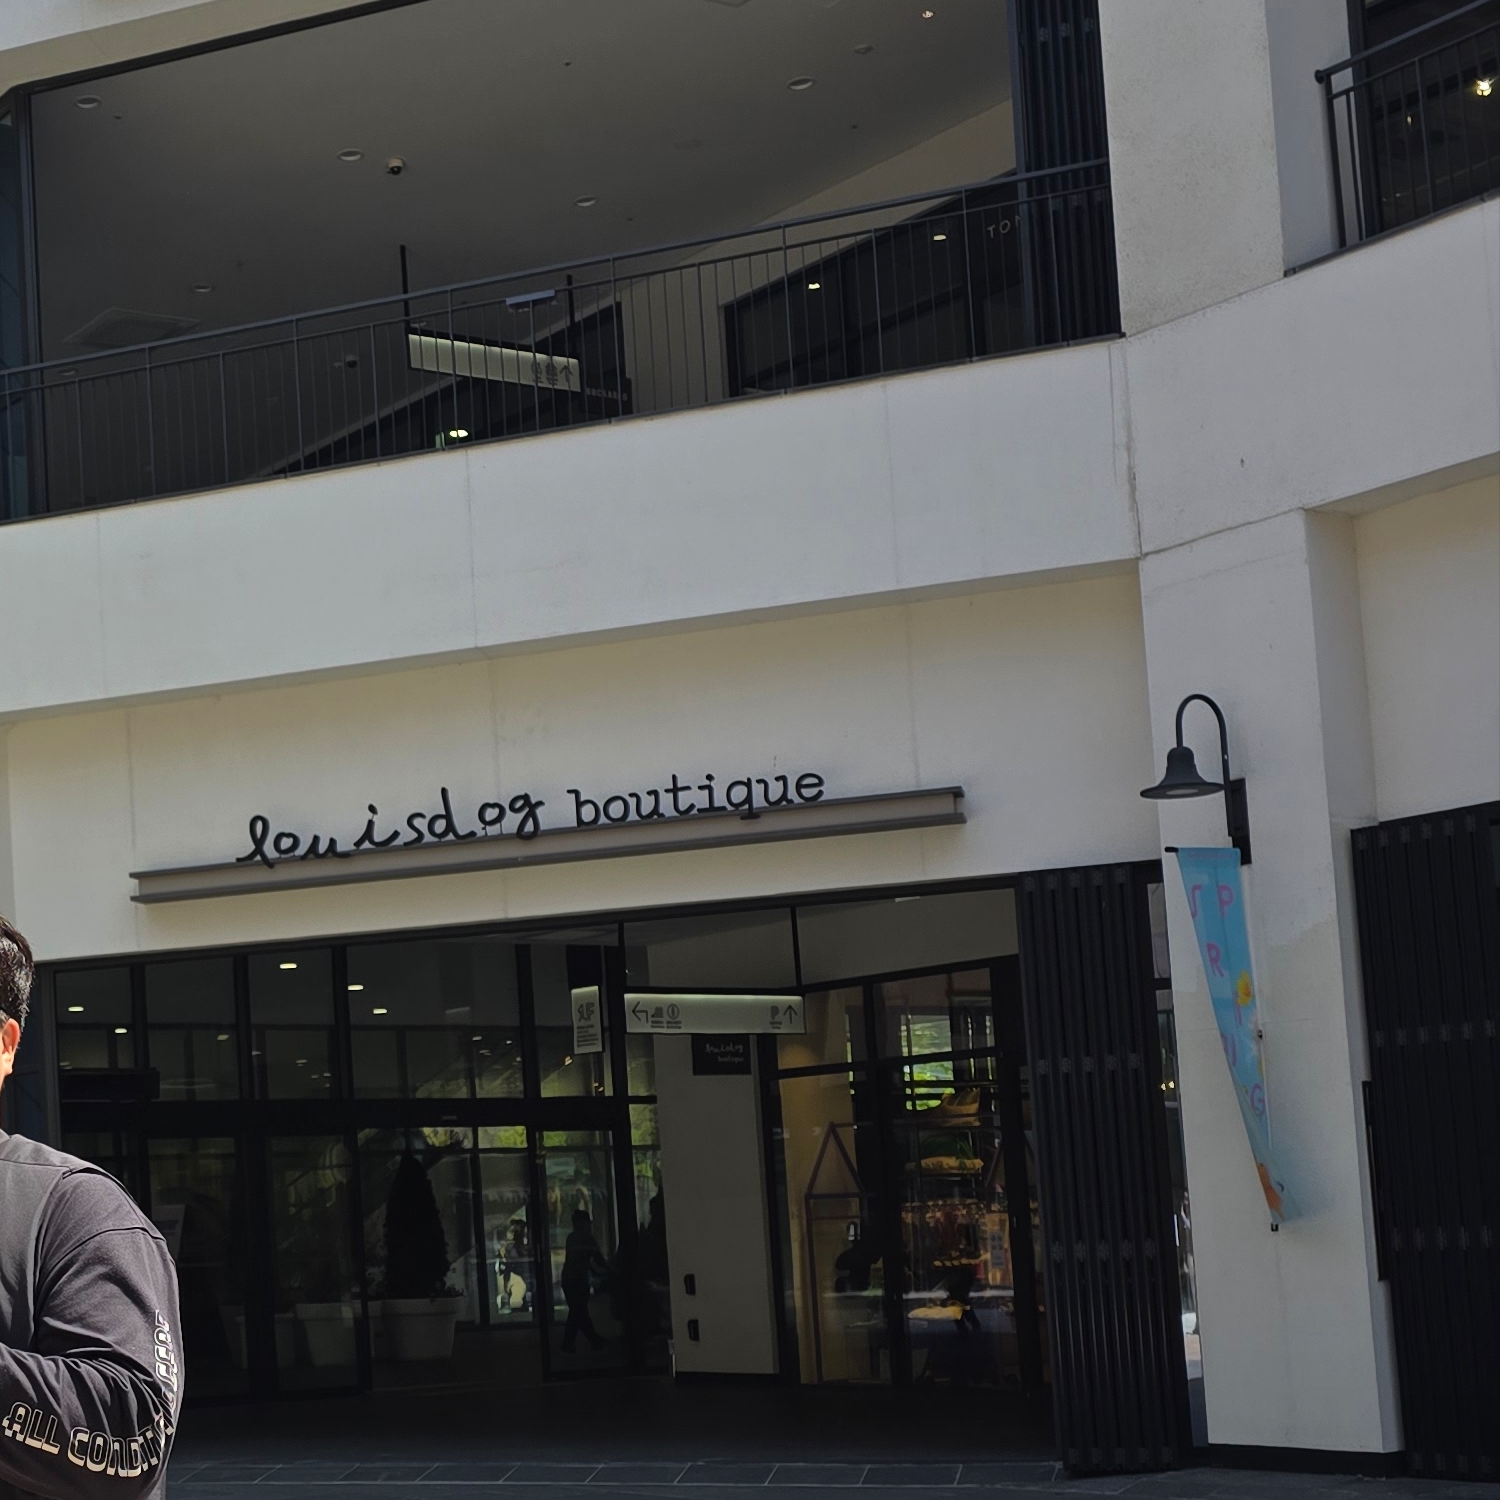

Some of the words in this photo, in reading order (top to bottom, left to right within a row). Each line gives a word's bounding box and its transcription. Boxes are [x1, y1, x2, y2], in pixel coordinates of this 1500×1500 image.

[236, 786, 545, 869] louisdog
[566, 772, 825, 821] boutique
[2, 1401, 61, 1455] ALL
